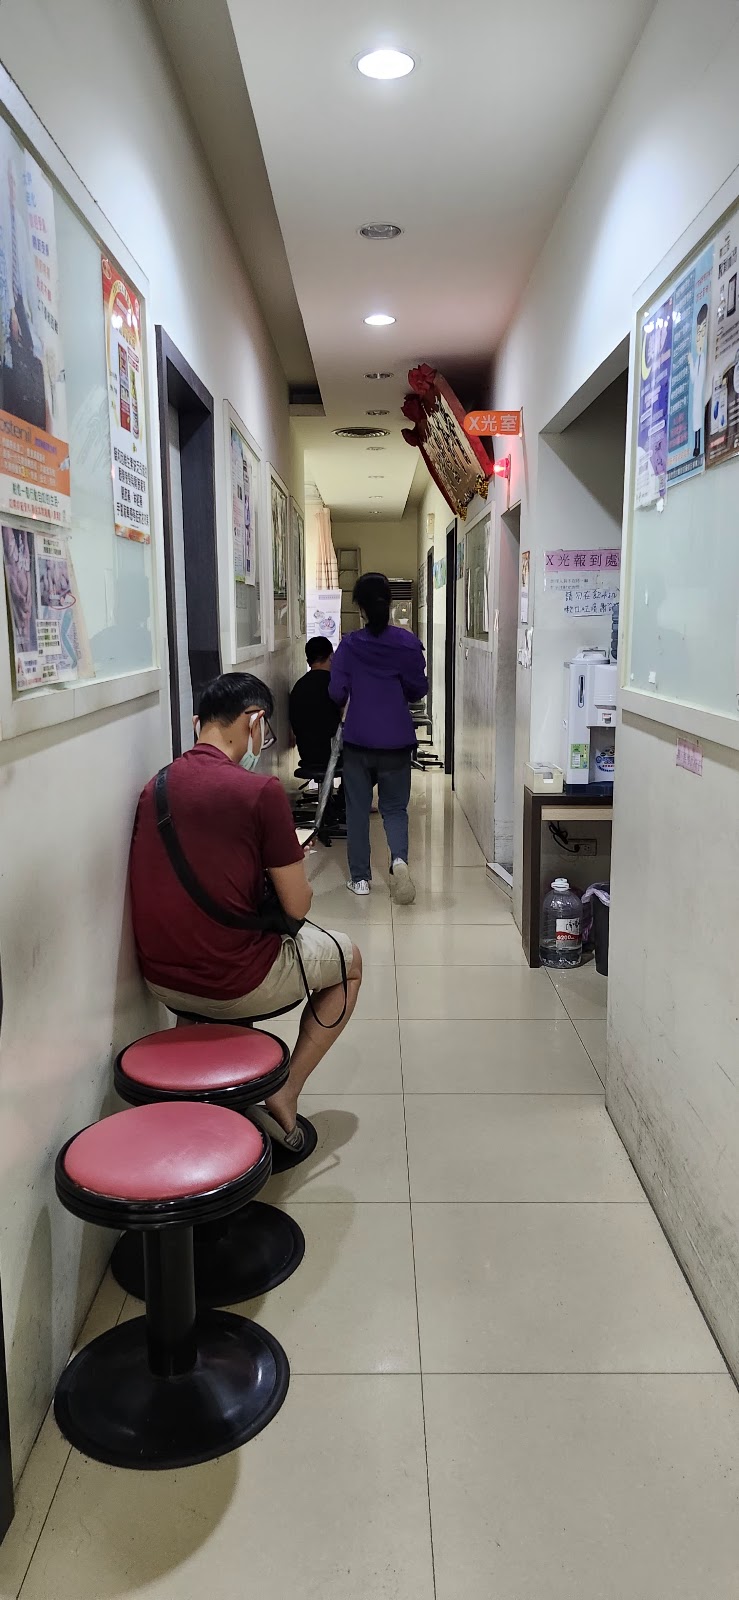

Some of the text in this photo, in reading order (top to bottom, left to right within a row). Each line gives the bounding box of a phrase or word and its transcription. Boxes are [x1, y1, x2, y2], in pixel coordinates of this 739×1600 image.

[468, 414, 518, 432] X光室
[545, 553, 618, 567] X光報到處
